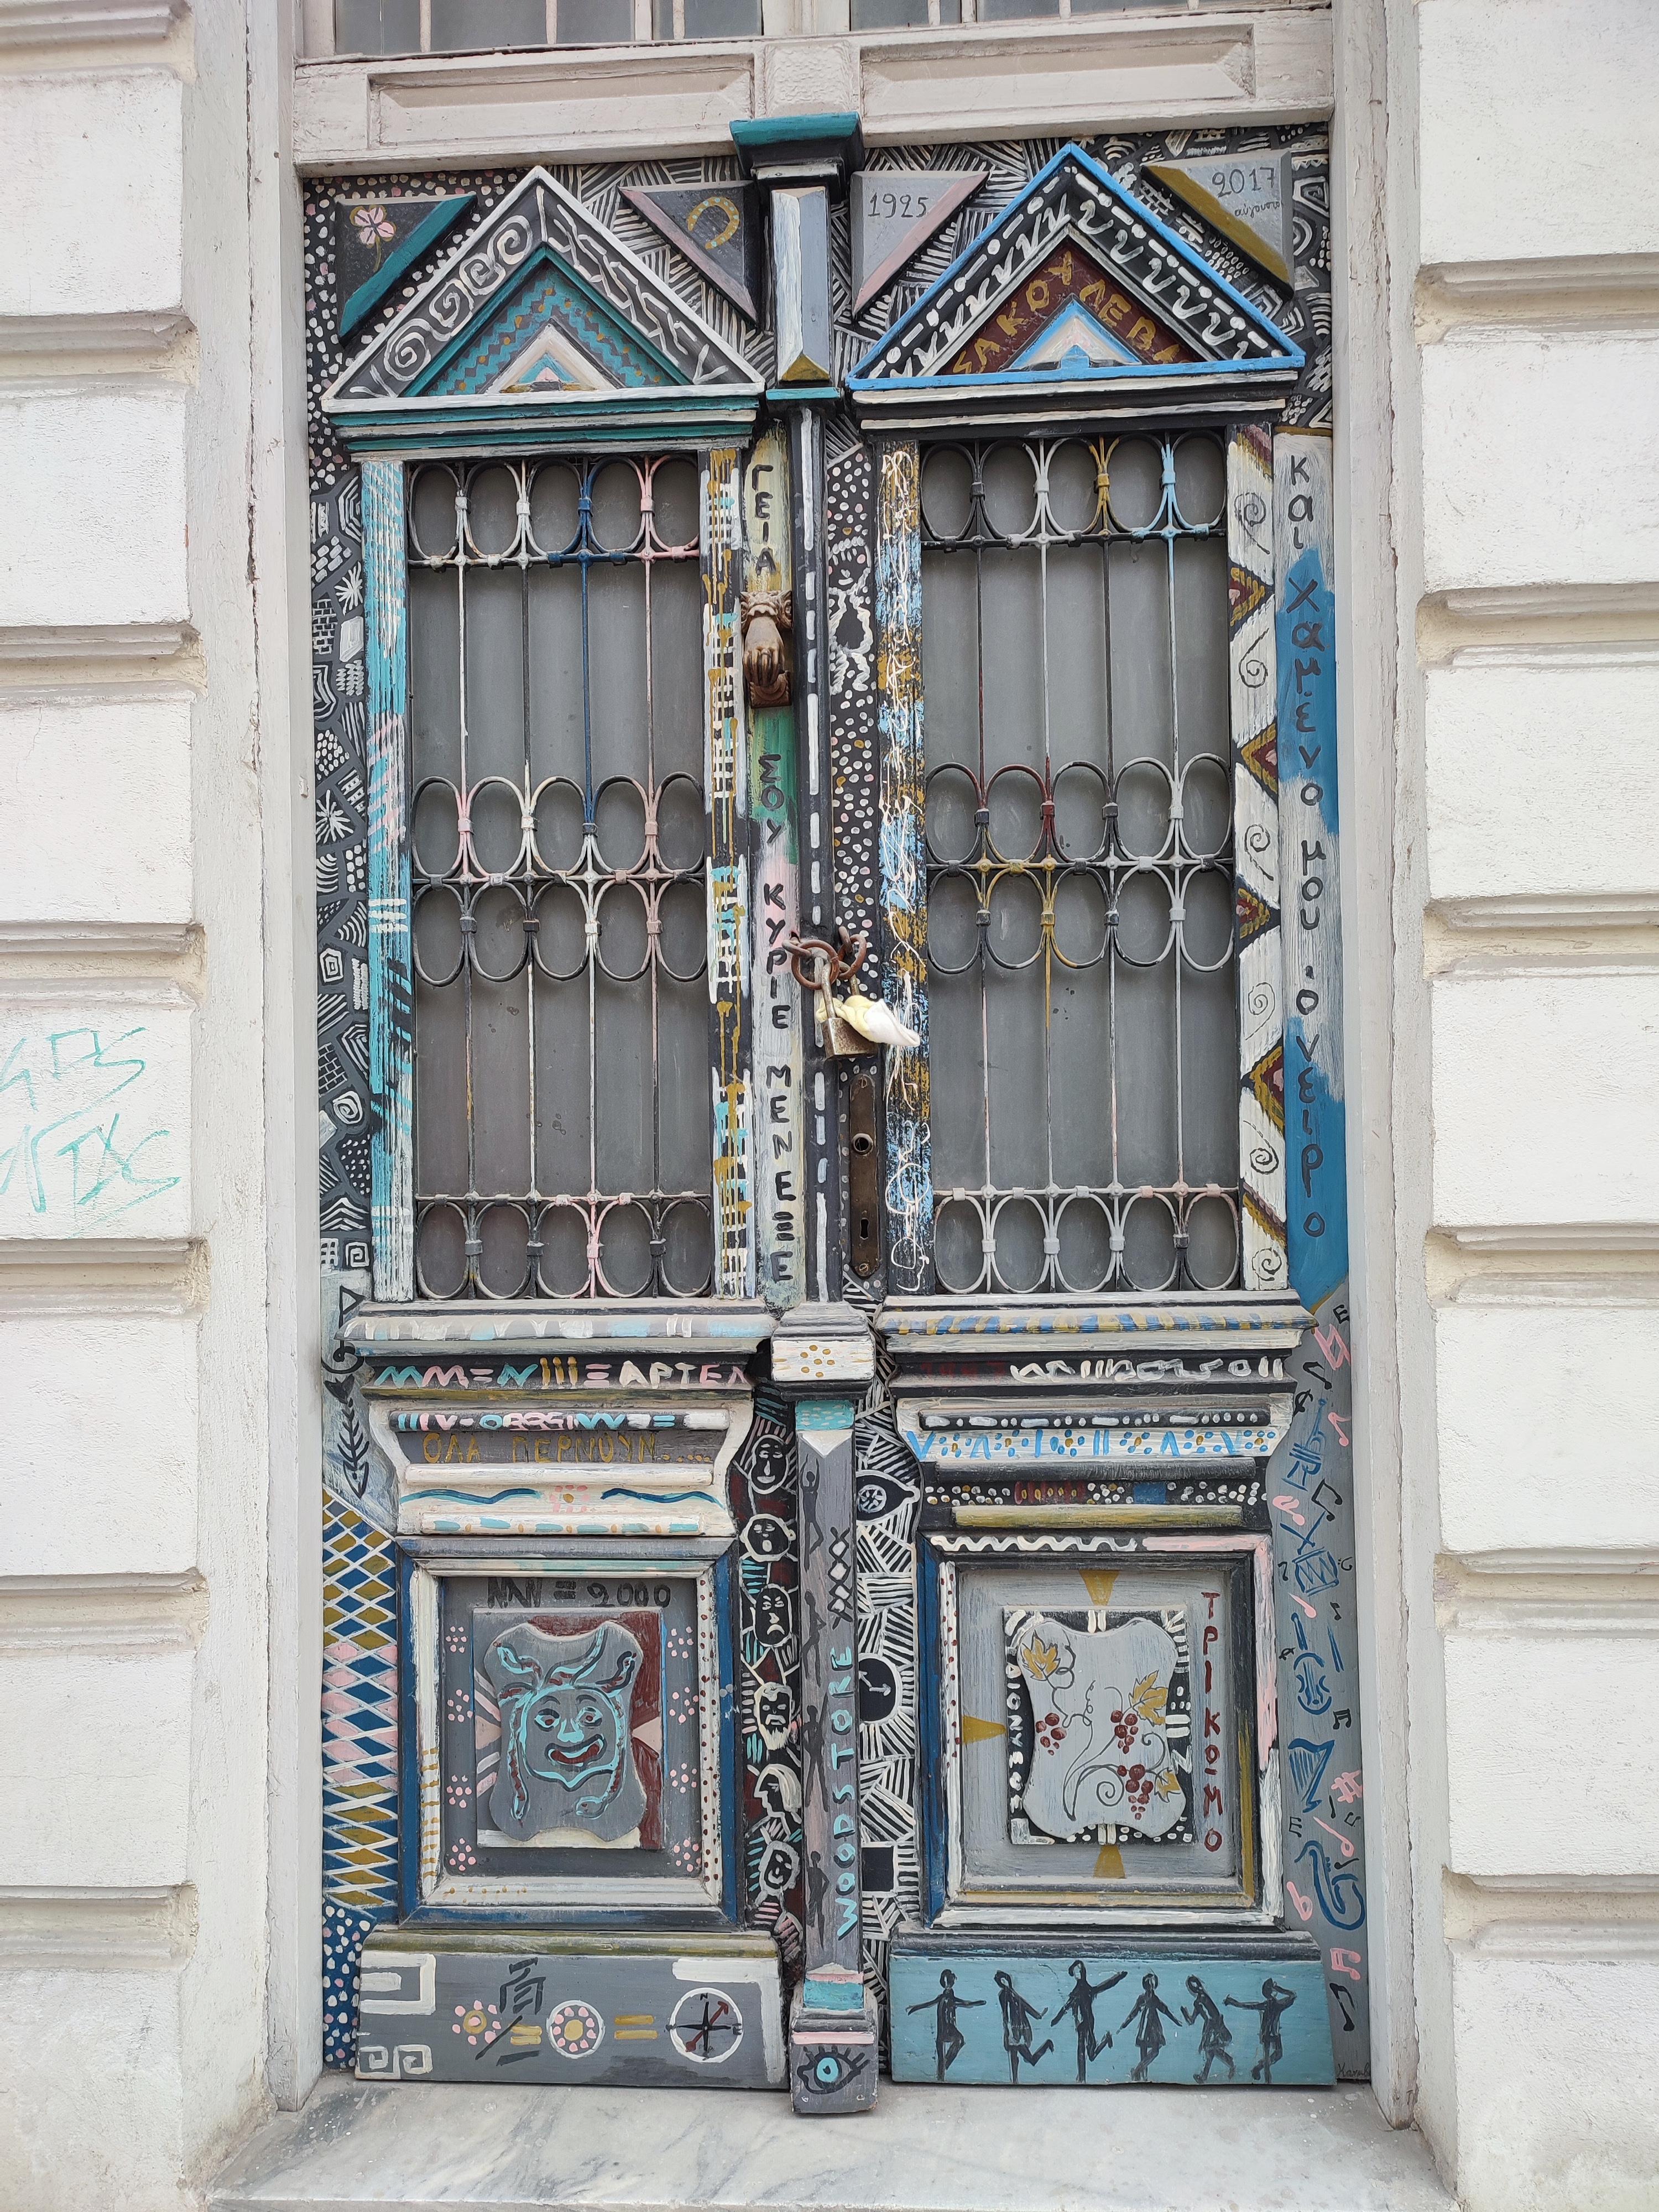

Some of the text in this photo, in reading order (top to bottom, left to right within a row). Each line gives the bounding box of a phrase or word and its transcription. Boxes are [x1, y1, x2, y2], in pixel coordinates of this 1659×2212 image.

[1212, 166, 1275, 197] 2017
[868, 192, 929, 218] 1925
[422, 1432, 481, 1463] ΟΛΑ
